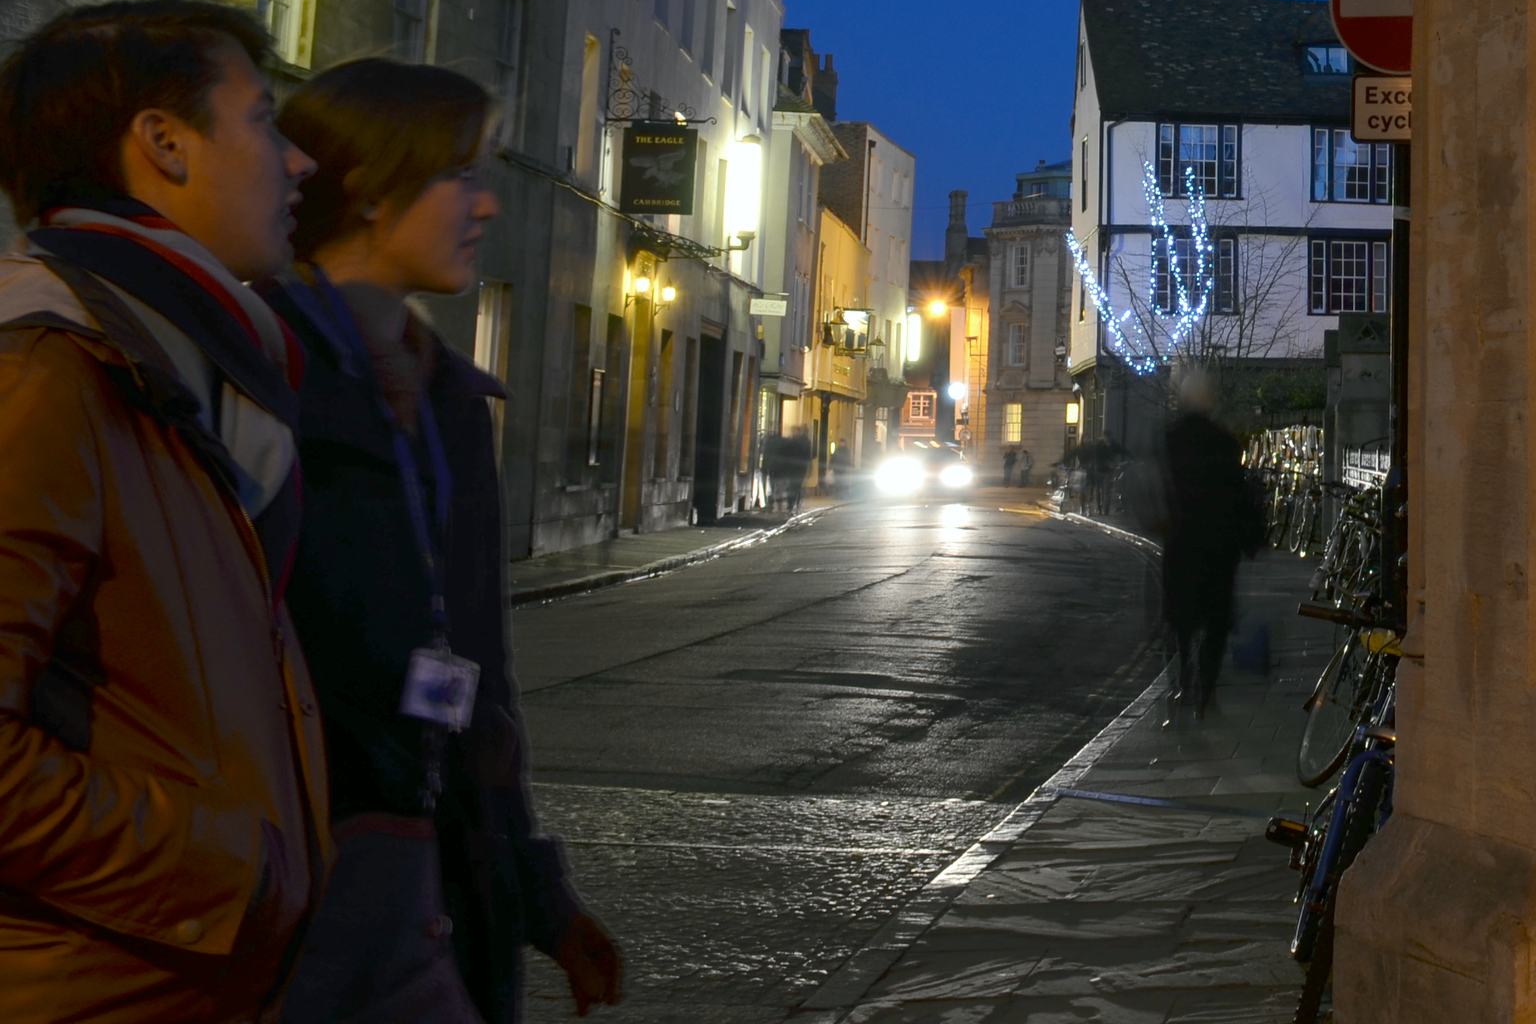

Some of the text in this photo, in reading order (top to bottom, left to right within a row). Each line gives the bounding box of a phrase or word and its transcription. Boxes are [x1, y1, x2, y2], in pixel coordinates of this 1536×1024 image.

[635, 136, 684, 145] THE EAGLE
[632, 199, 681, 207] CAMBRIDGE
